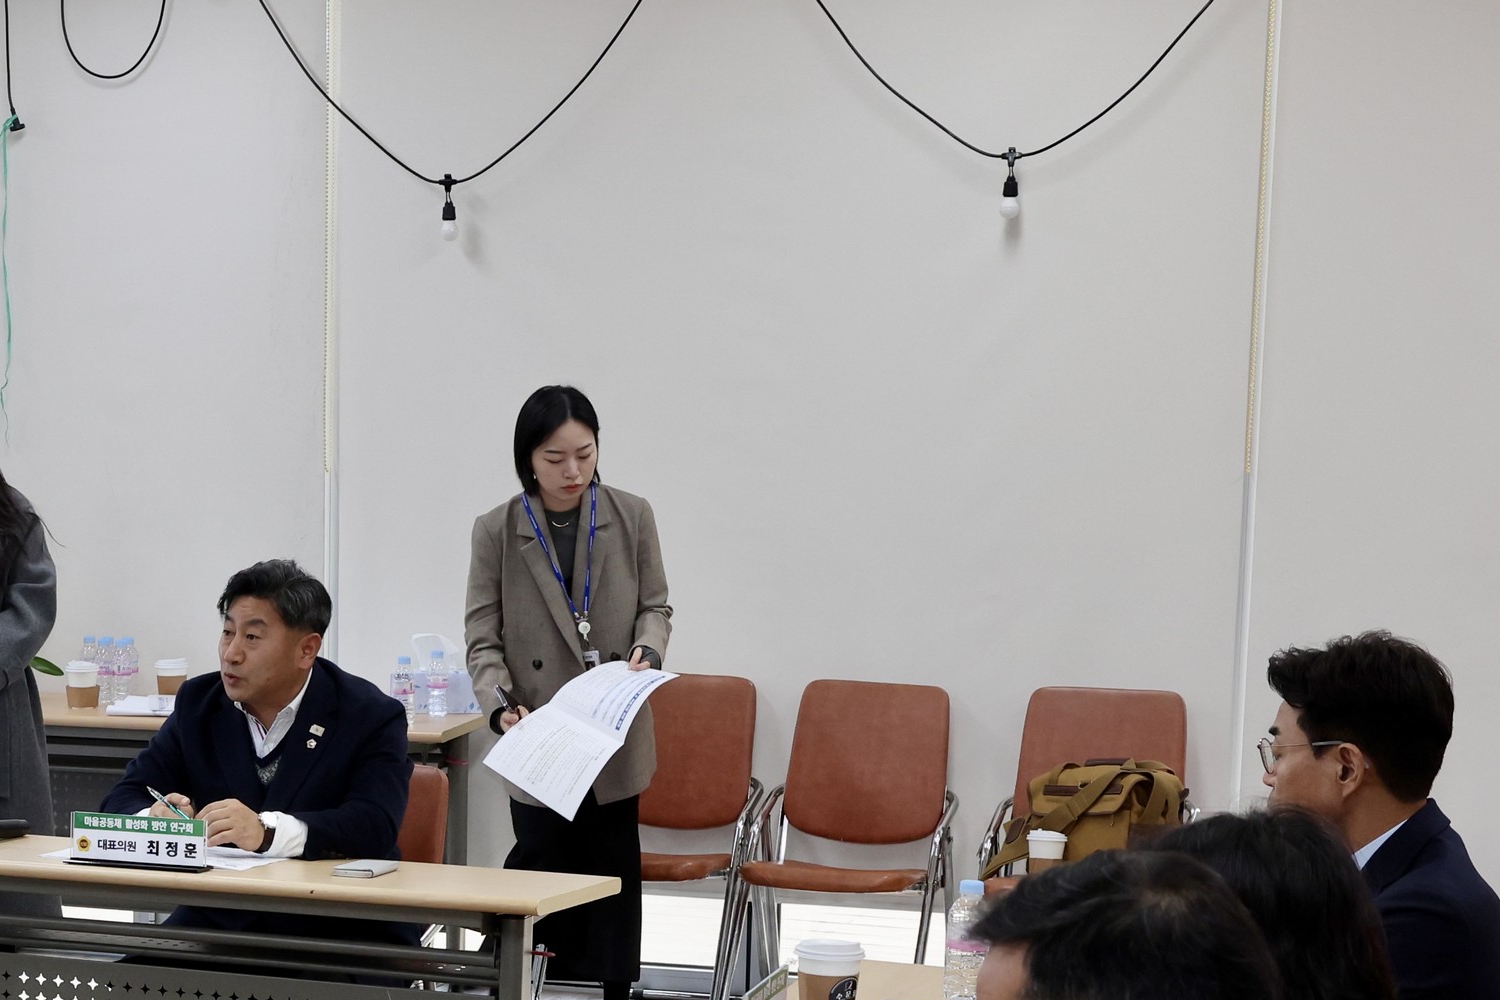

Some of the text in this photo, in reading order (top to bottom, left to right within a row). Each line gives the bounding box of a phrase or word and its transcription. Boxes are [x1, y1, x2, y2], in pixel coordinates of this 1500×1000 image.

[84, 816, 194, 834] 마을공동체 활성화 방안 연구회
[97, 839, 198, 859] 대표의원 최정훈
